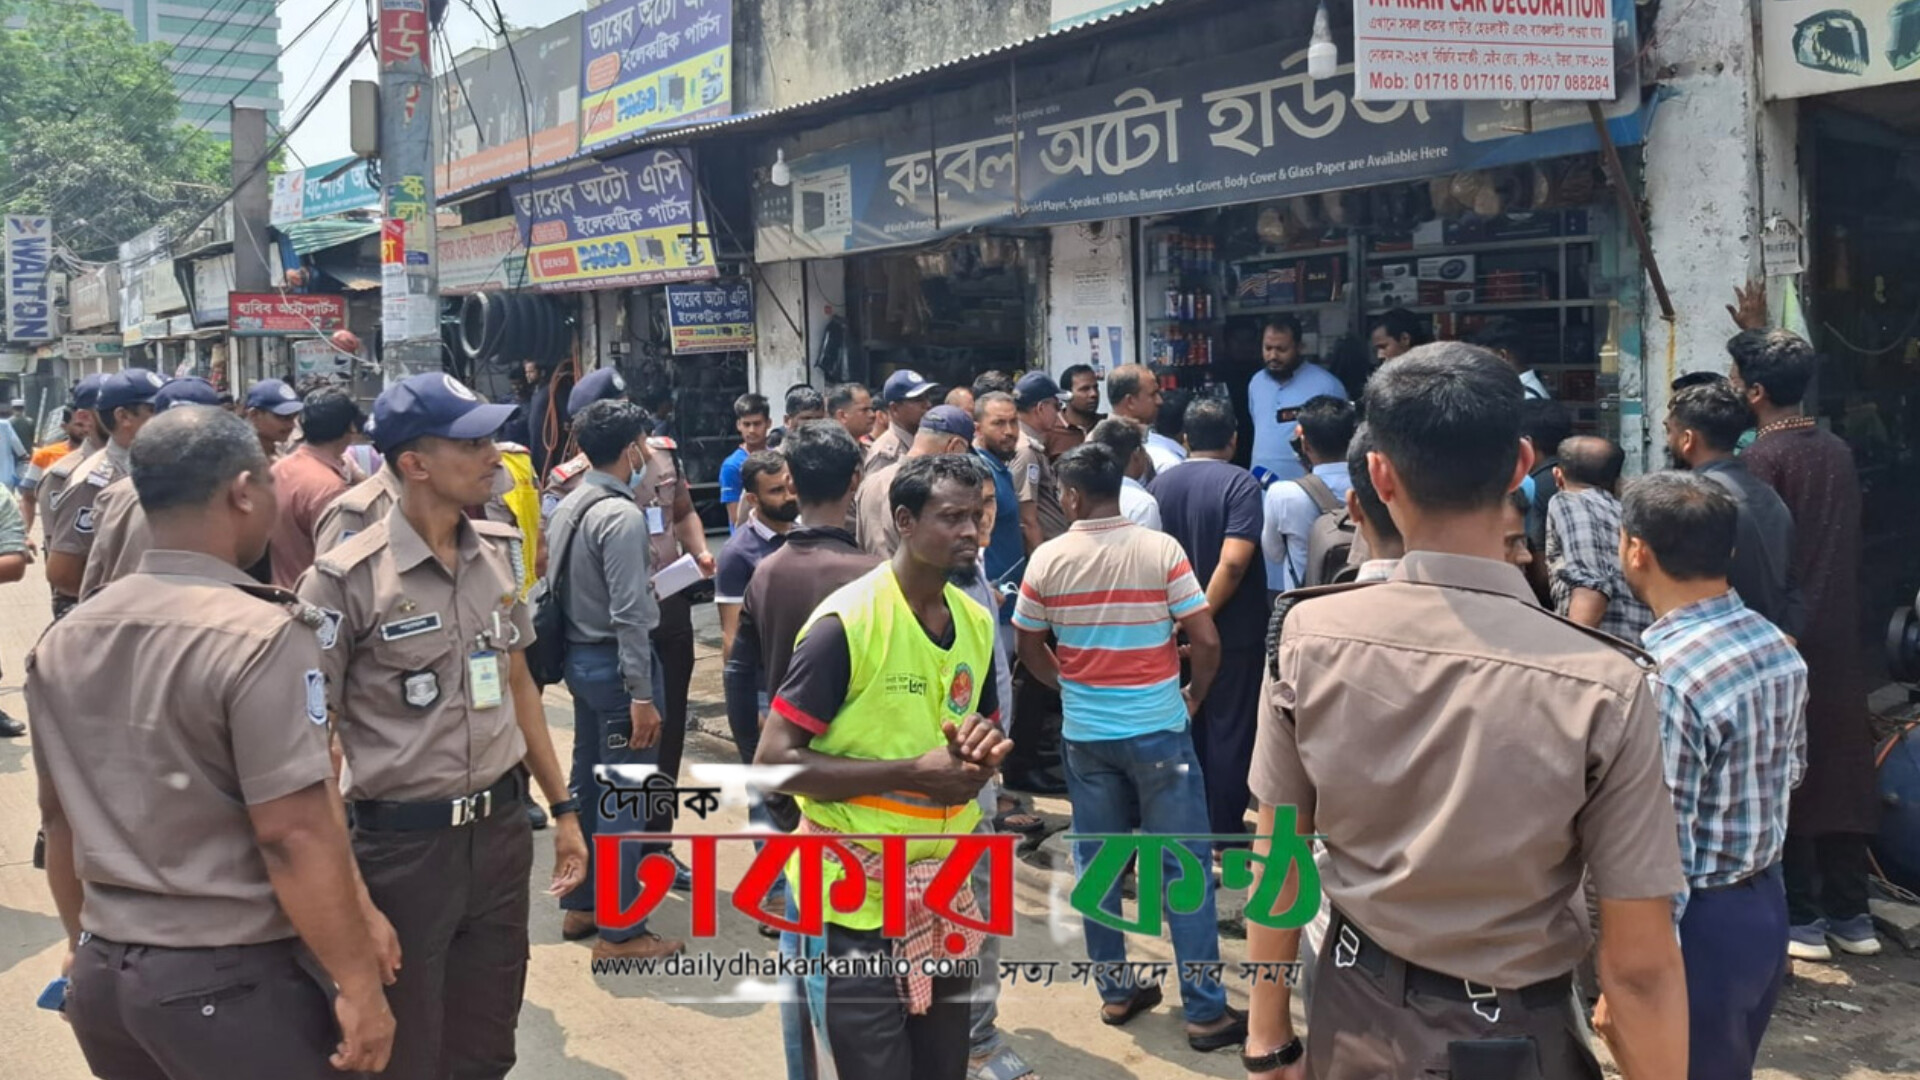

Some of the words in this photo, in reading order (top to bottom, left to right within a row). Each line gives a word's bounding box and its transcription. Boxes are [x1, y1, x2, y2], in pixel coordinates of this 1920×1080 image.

[588, 6, 635, 49] তায়েব
[621, 32, 681, 71] ইলেকট্রিক
[685, 10, 722, 44] পার্টস
[1370, 71, 1409, 90] Mob:
[1414, 72, 1459, 90] 01718
[1520, 74, 1560, 91] 01707
[1565, 75, 1609, 91] 088284
[1037, 88, 1182, 176] অটো
[515, 184, 576, 218] তায়েব
[577, 166, 631, 206] অটো
[638, 151, 684, 195] এসি
[1175, 183, 1194, 197] Seat
[1196, 179, 1222, 192] Cover,
[1224, 175, 1248, 189] Body
[1250, 171, 1277, 185] Cover
[1279, 168, 1286, 180] &
[1288, 165, 1314, 179] Glass
[1316, 162, 1346, 177] Paper
[1348, 159, 1365, 171] are
[1367, 151, 1419, 168] Available
[1420, 145, 1448, 160] Here
[573, 205, 643, 236] ইলেকট্রিক
[648, 195, 691, 224] পার্টস
[12, 237, 48, 337] WALTON
